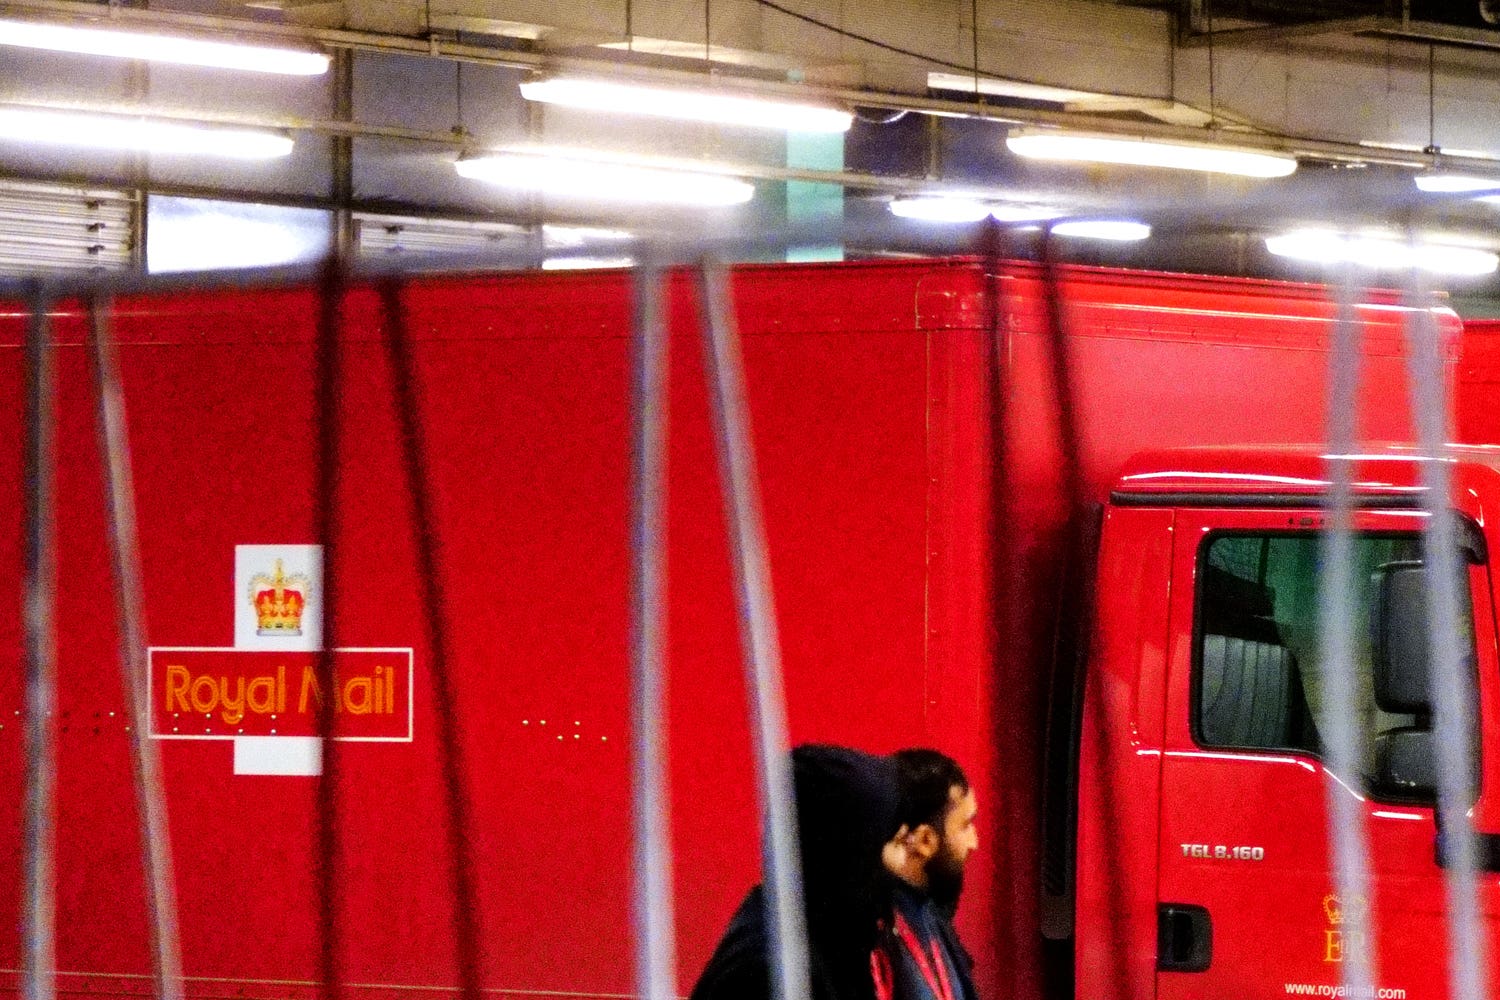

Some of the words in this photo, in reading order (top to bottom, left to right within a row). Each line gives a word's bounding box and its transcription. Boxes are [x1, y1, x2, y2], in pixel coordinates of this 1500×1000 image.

[165, 665, 286, 724] Royal
[298, 665, 394, 715] Mail
[1180, 843, 1212, 858] TGL
[1214, 845, 1264, 861] 8.160
